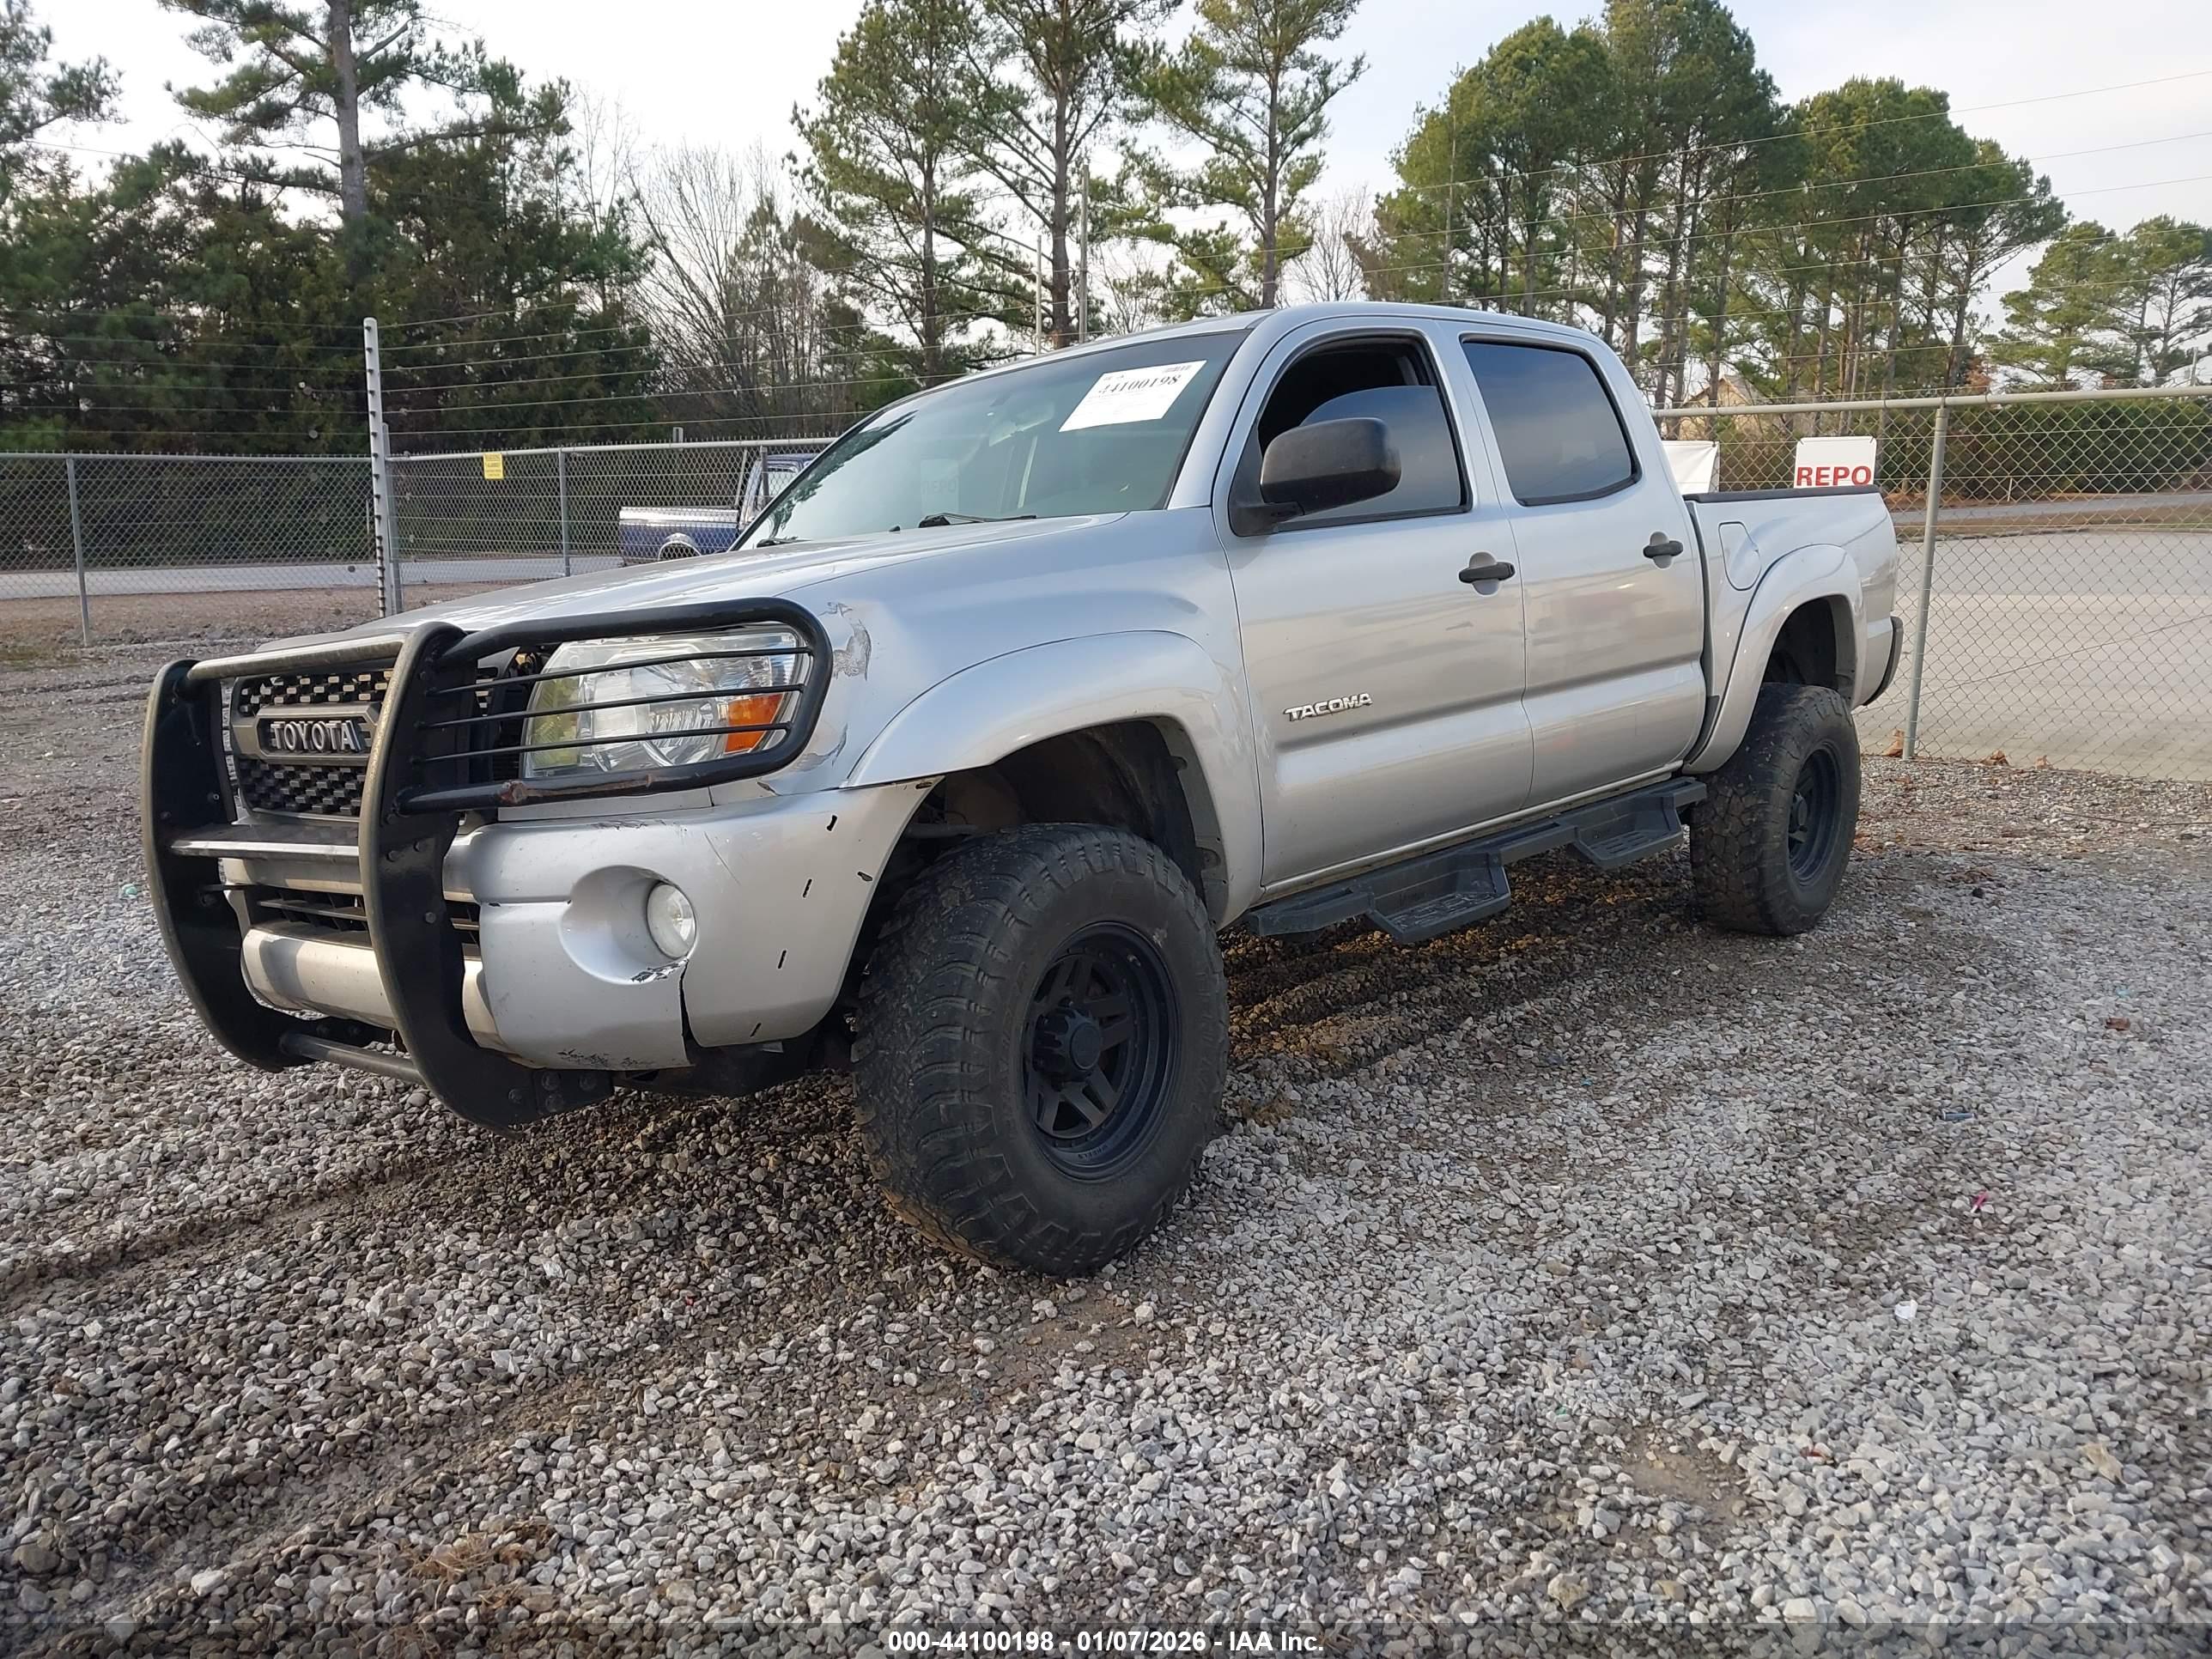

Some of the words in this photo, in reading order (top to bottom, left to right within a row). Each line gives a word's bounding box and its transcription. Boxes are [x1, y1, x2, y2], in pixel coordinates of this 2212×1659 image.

[1796, 465, 1872, 487] REPO
[1283, 692, 1373, 722] TACOMA
[270, 720, 362, 751] TOYOTA
